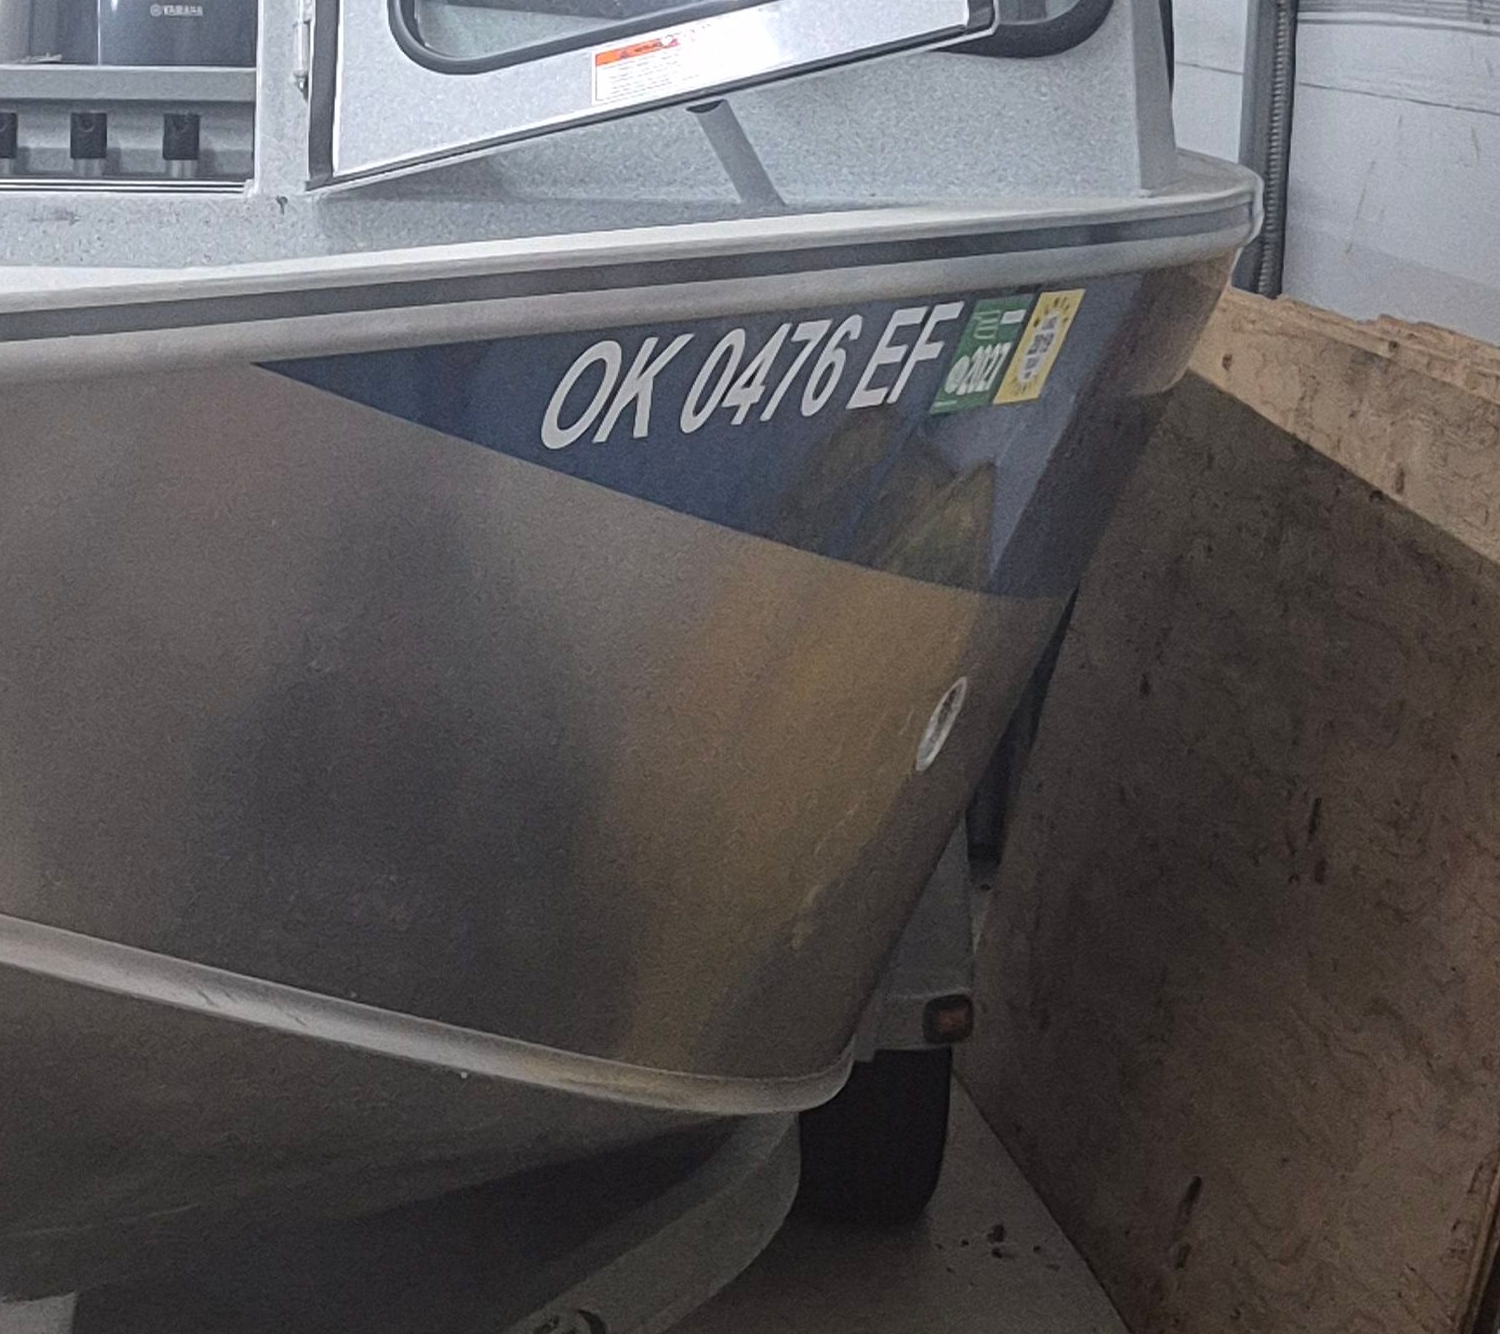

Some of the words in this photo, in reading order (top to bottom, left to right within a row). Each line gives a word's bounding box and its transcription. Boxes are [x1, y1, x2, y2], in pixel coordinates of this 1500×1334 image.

[540, 333, 695, 450] OK
[679, 313, 863, 434] 0476
[845, 300, 965, 411] EF
